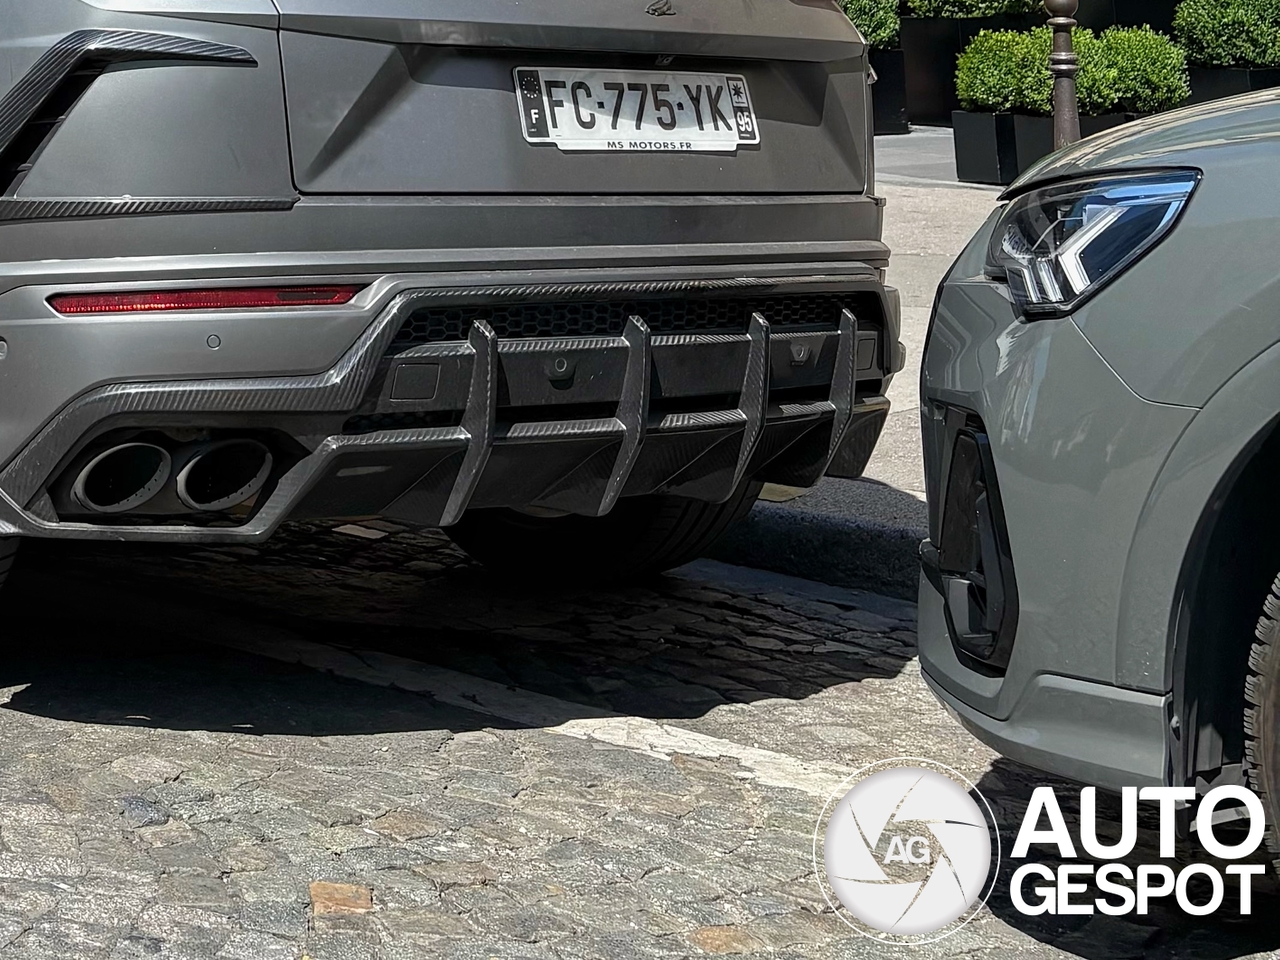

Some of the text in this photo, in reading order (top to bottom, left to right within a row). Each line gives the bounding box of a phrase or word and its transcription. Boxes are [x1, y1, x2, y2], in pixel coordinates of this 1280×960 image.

[530, 109, 540, 124] F
[736, 111, 753, 132] 95
[607, 141, 692, 150] MS MOTORS.FR
